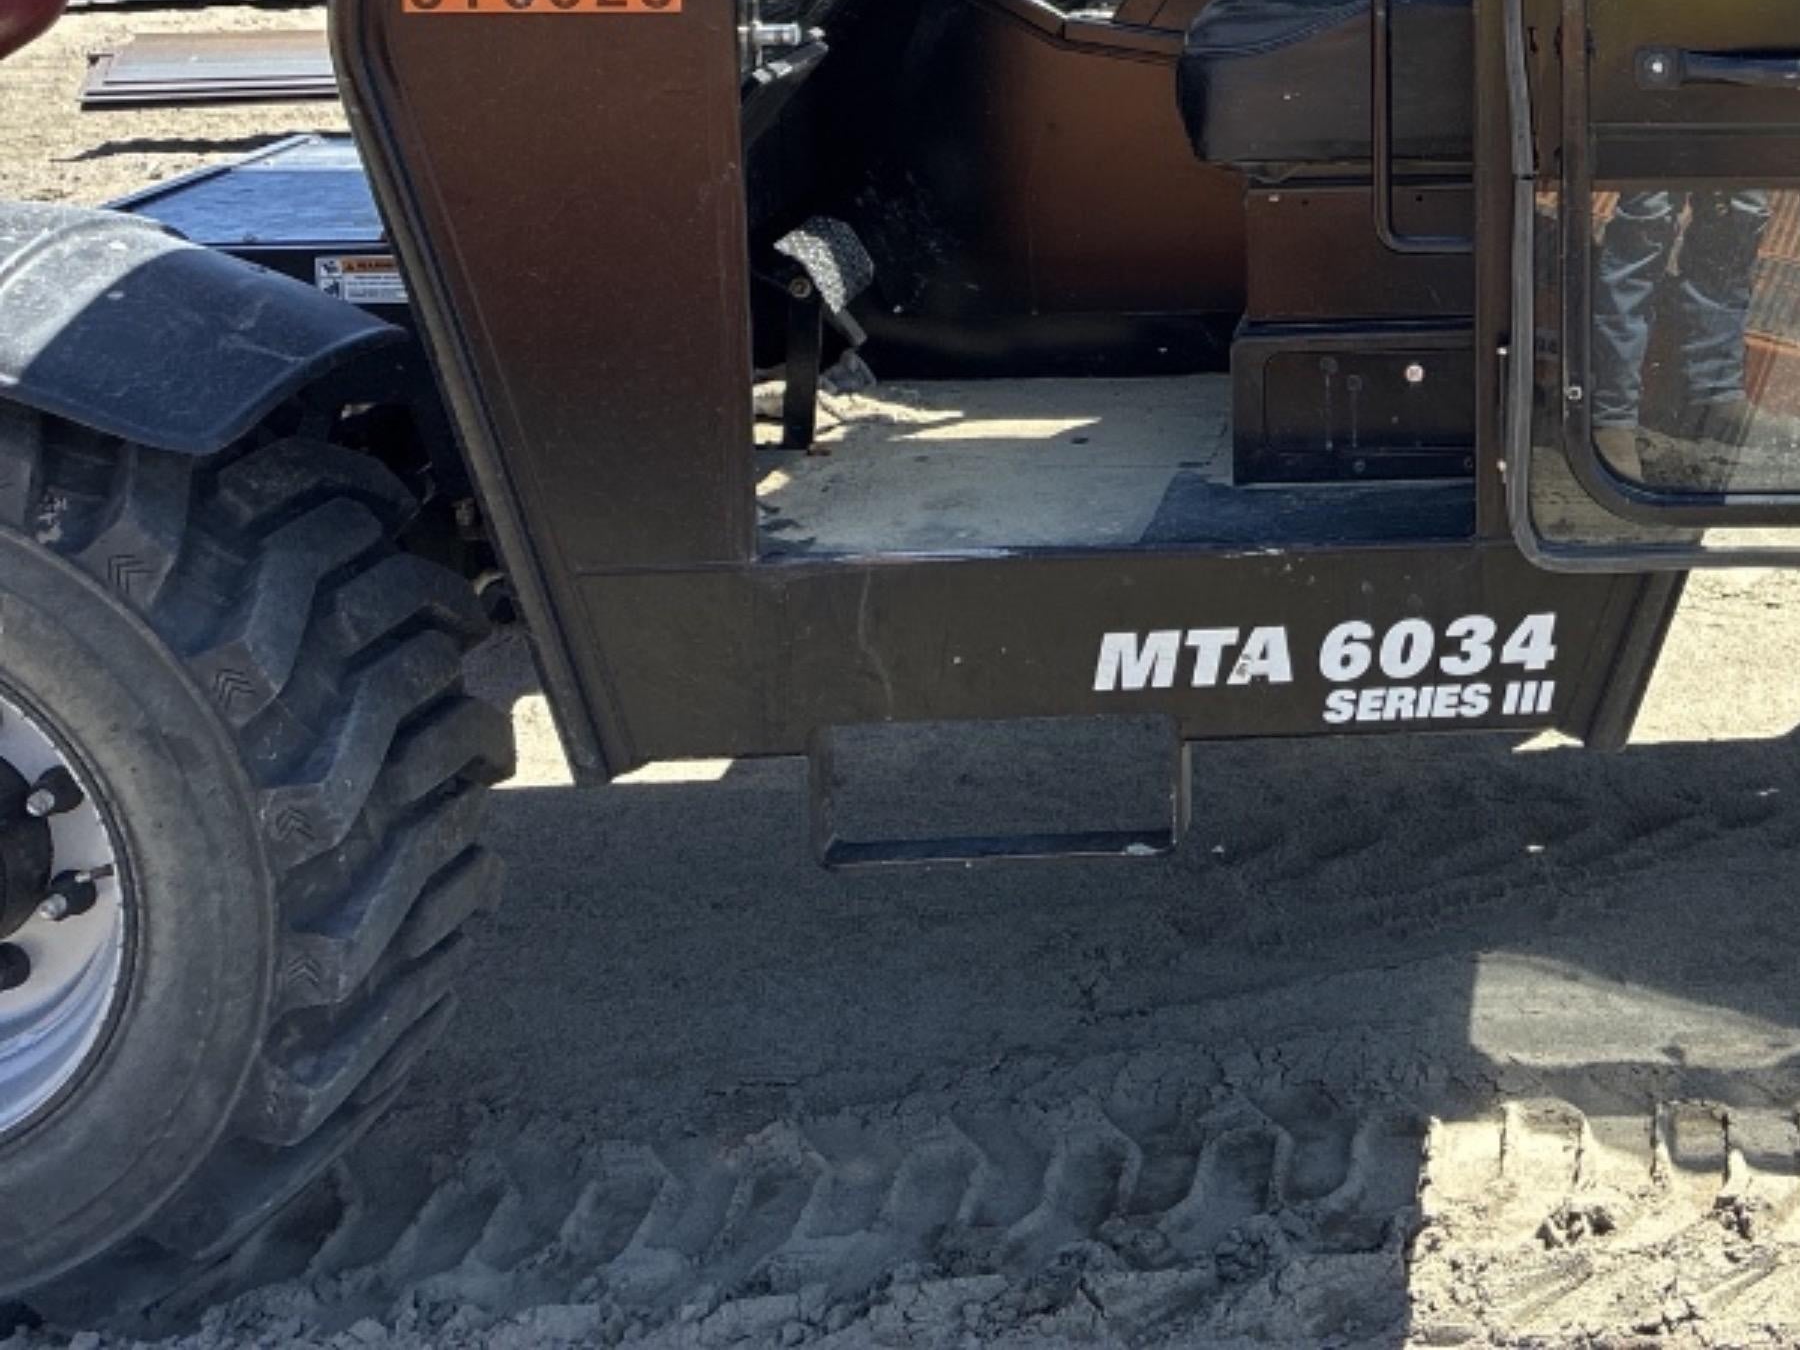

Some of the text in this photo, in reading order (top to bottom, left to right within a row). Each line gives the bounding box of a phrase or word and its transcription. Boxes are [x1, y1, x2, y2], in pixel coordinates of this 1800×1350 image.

[1092, 612, 1558, 690] MTA 6034
[1323, 680, 1556, 723] SERIES III
